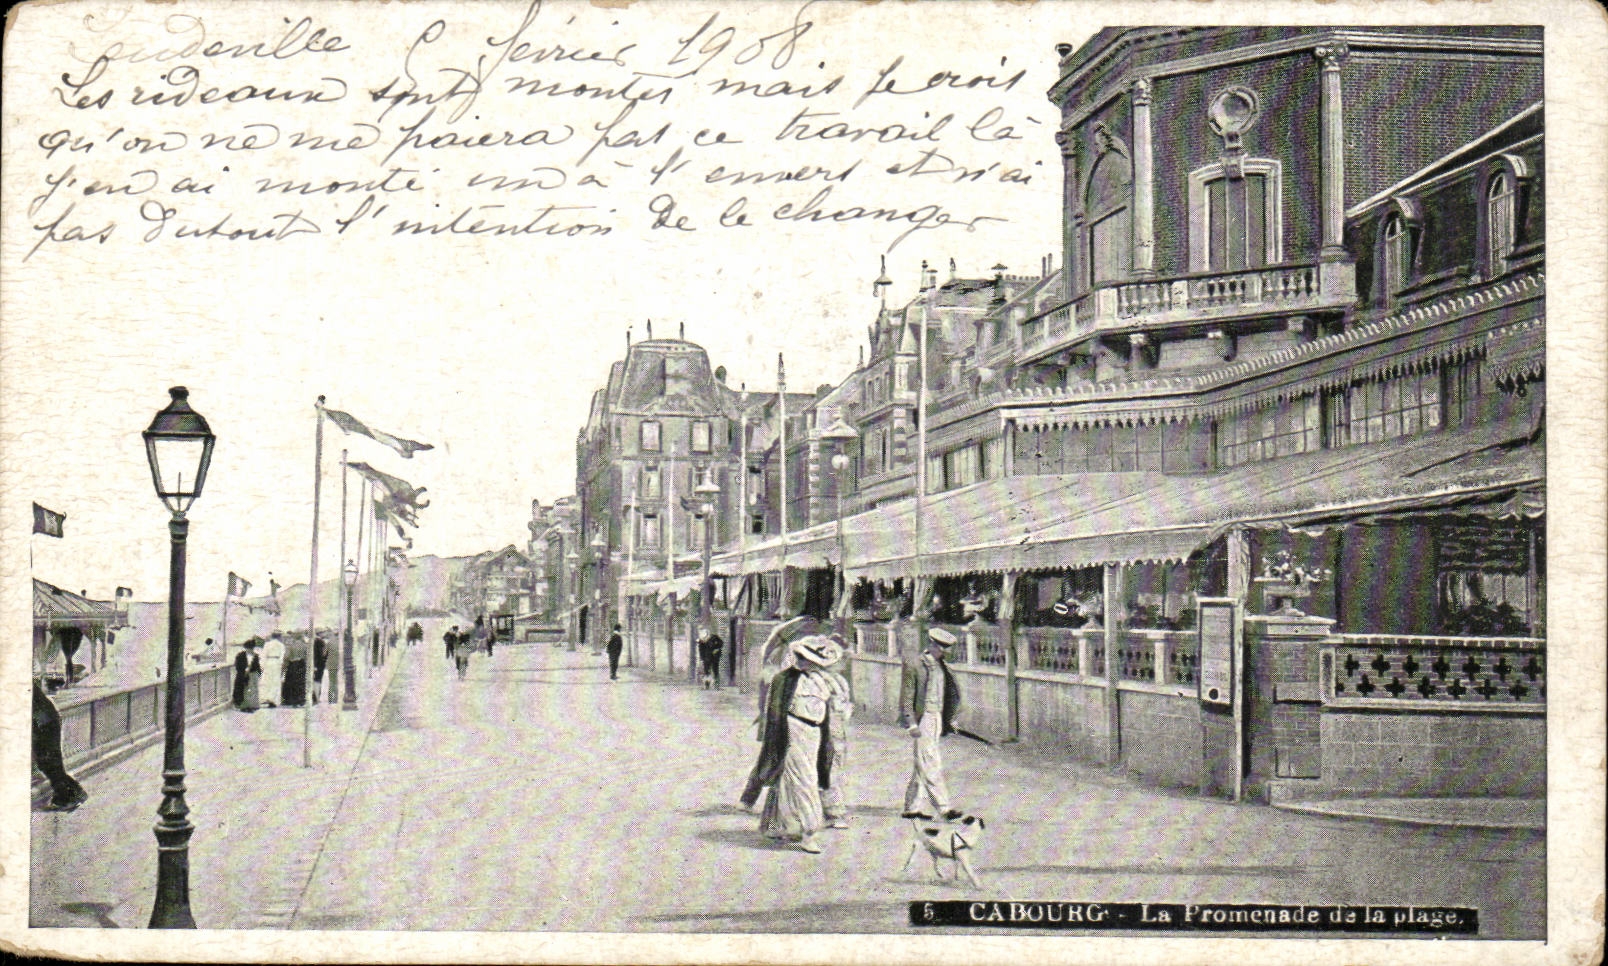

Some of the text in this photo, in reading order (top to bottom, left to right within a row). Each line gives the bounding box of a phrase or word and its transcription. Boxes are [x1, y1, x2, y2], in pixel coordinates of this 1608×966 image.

[667, 1, 828, 79] 1908
[53, 55, 114, 110] Les
[131, 65, 348, 107] rideaux
[706, 60, 847, 99] mais
[200, 123, 281, 152] ne
[288, 123, 382, 152] me
[380, 105, 575, 168] paiera
[576, 99, 674, 168] pas
[693, 128, 744, 147] ce
[774, 106, 956, 143] travail
[965, 105, 1043, 143] là
[170, 165, 224, 195] ai
[467, 166, 567, 191] un
[577, 160, 634, 189] à
[22, 202, 118, 262] pas
[719, 196, 754, 227] le
[772, 184, 1010, 255] changer
